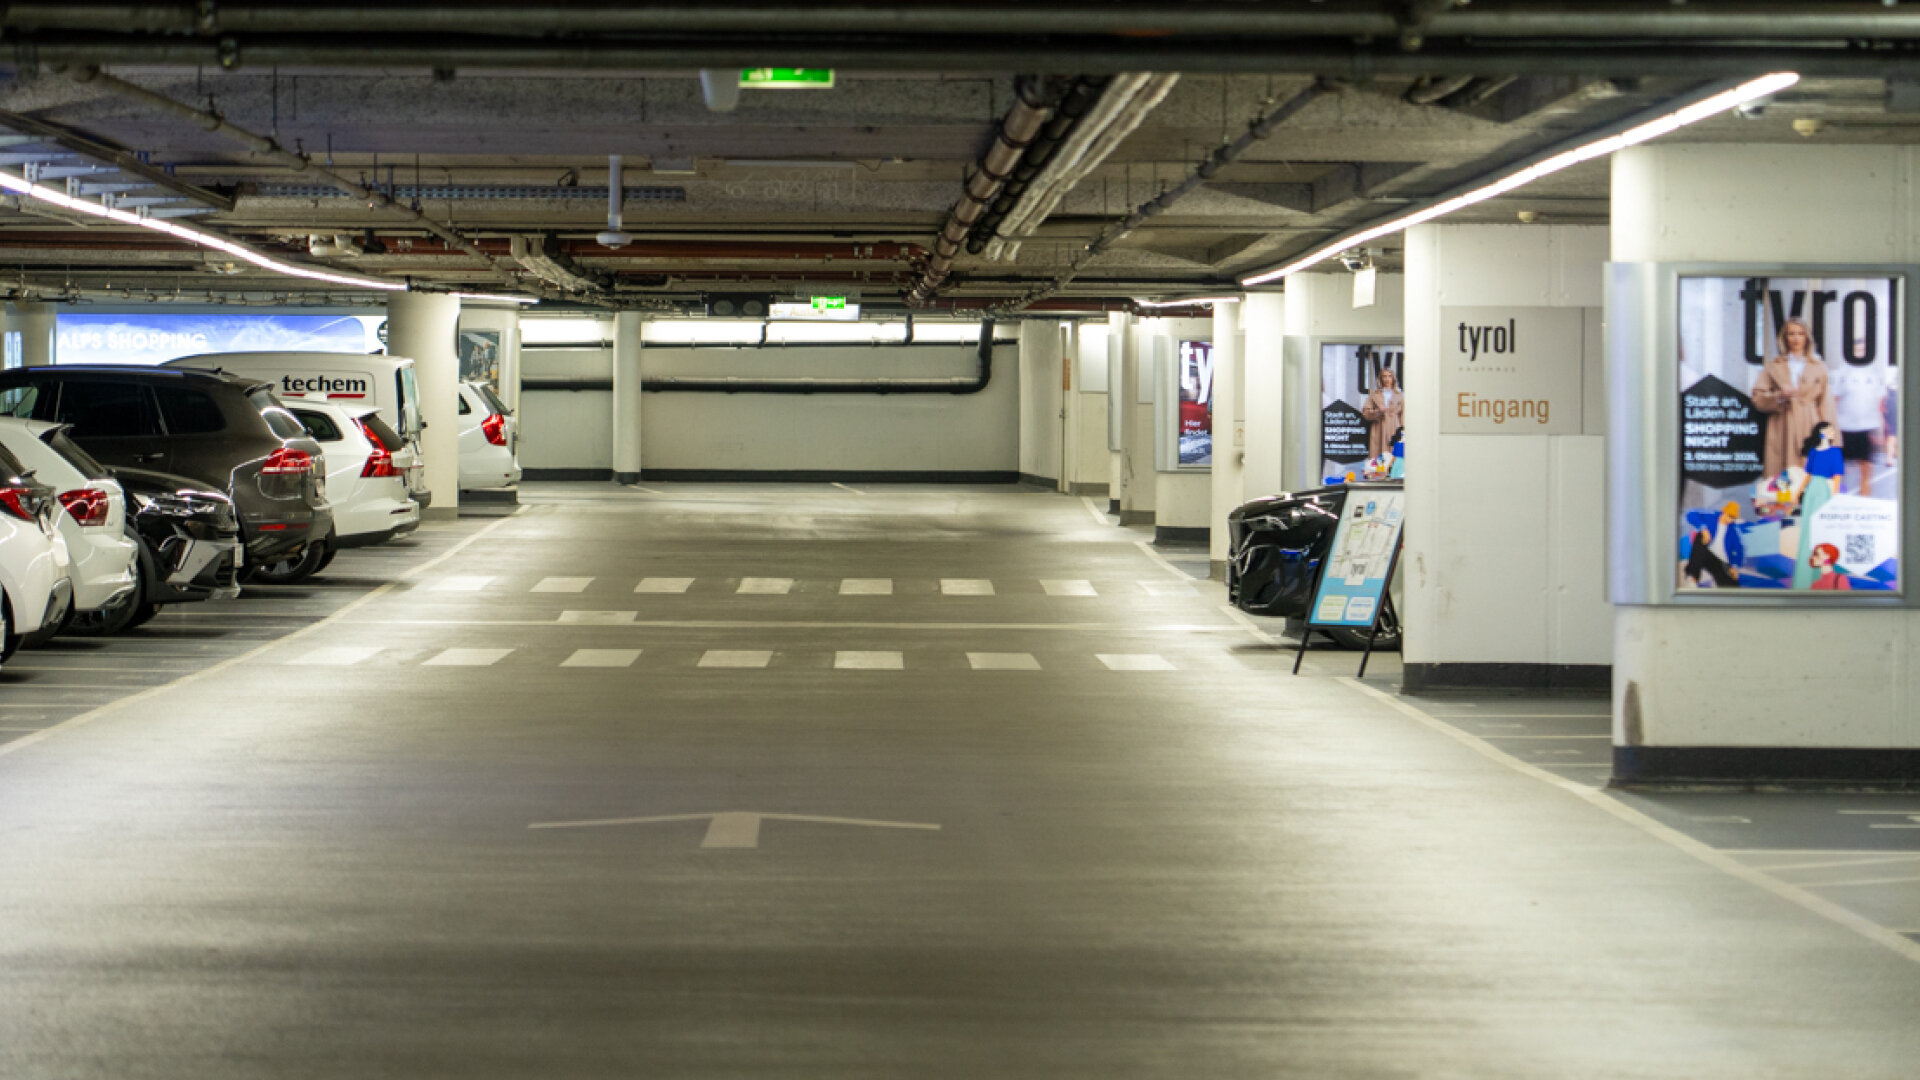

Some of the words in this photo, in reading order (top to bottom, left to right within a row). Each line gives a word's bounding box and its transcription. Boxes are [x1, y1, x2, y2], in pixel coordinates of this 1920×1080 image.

[57, 331, 102, 350] ALPS
[108, 331, 207, 351] SHOPPING
[1458, 318, 1515, 361] tyrol
[282, 374, 366, 392] techem
[1457, 392, 1550, 424] Eingang
[1685, 395, 1719, 407] Stadt
[1722, 397, 1741, 408] an,
[1685, 406, 1725, 419] Läden
[1727, 407, 1748, 419] auf
[1684, 422, 1758, 434] SHOPPING
[1684, 435, 1729, 447] NIGHT
